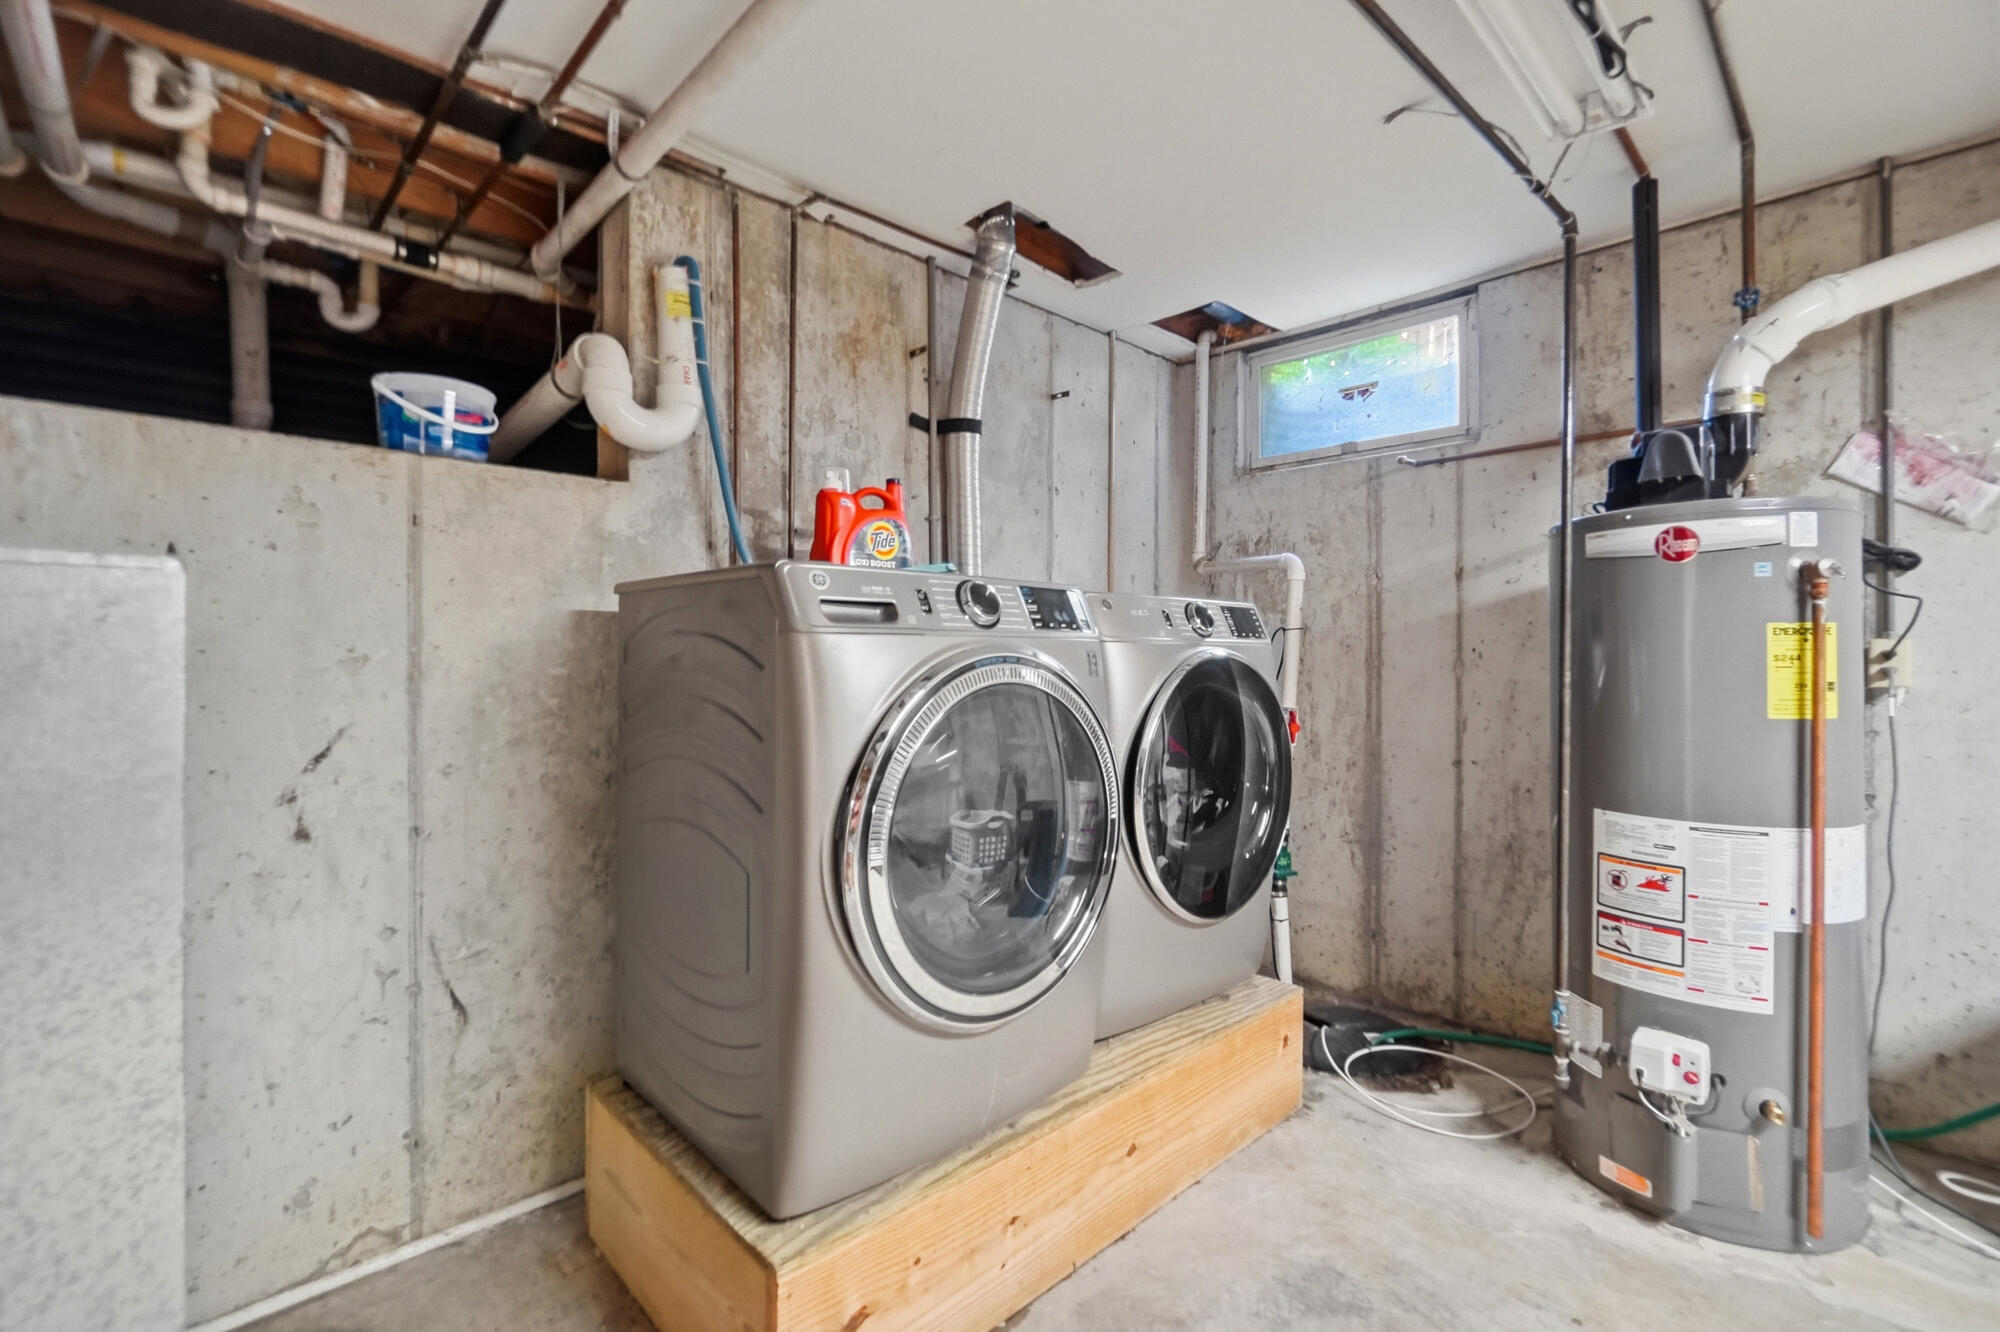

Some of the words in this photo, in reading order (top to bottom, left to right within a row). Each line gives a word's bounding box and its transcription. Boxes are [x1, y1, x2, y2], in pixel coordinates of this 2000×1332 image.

[871, 531, 896, 552] Tide
[855, 558, 870, 566] OXI
[870, 559, 897, 569] BOOST
